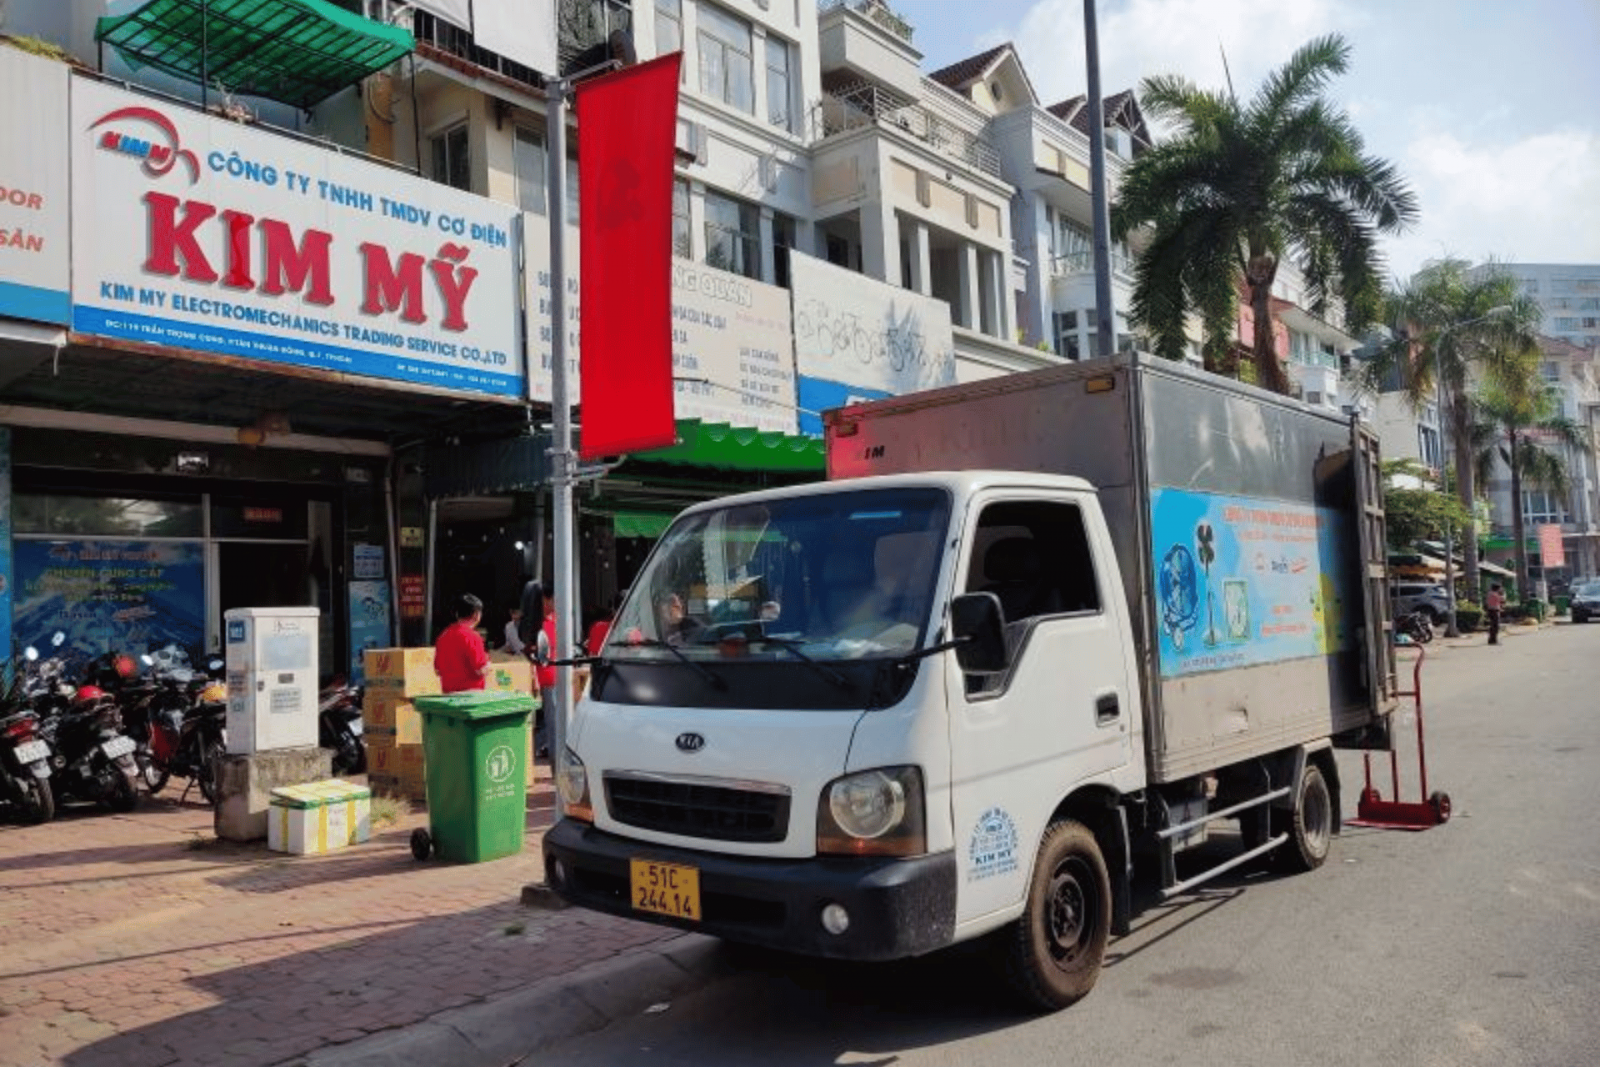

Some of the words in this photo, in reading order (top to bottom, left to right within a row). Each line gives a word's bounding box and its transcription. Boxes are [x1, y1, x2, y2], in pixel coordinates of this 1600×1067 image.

[207, 151, 278, 186] CÔNG
[285, 170, 310, 194] TY
[318, 180, 373, 212] TNHH
[380, 197, 431, 227] TMDV
[437, 214, 465, 236] CƠ
[470, 223, 506, 248] ĐIỆN
[142, 190, 335, 306] KIM
[359, 241, 478, 332] MỸ
[100, 281, 135, 302] KIM
[139, 288, 166, 307] MY
[171, 294, 339, 336] ELECTROMECHANICS
[343, 324, 404, 348] TRADING
[407, 336, 457, 358] SERVICE
[639, 887, 692, 916] 244.14
[649, 865, 679, 890] 51C
